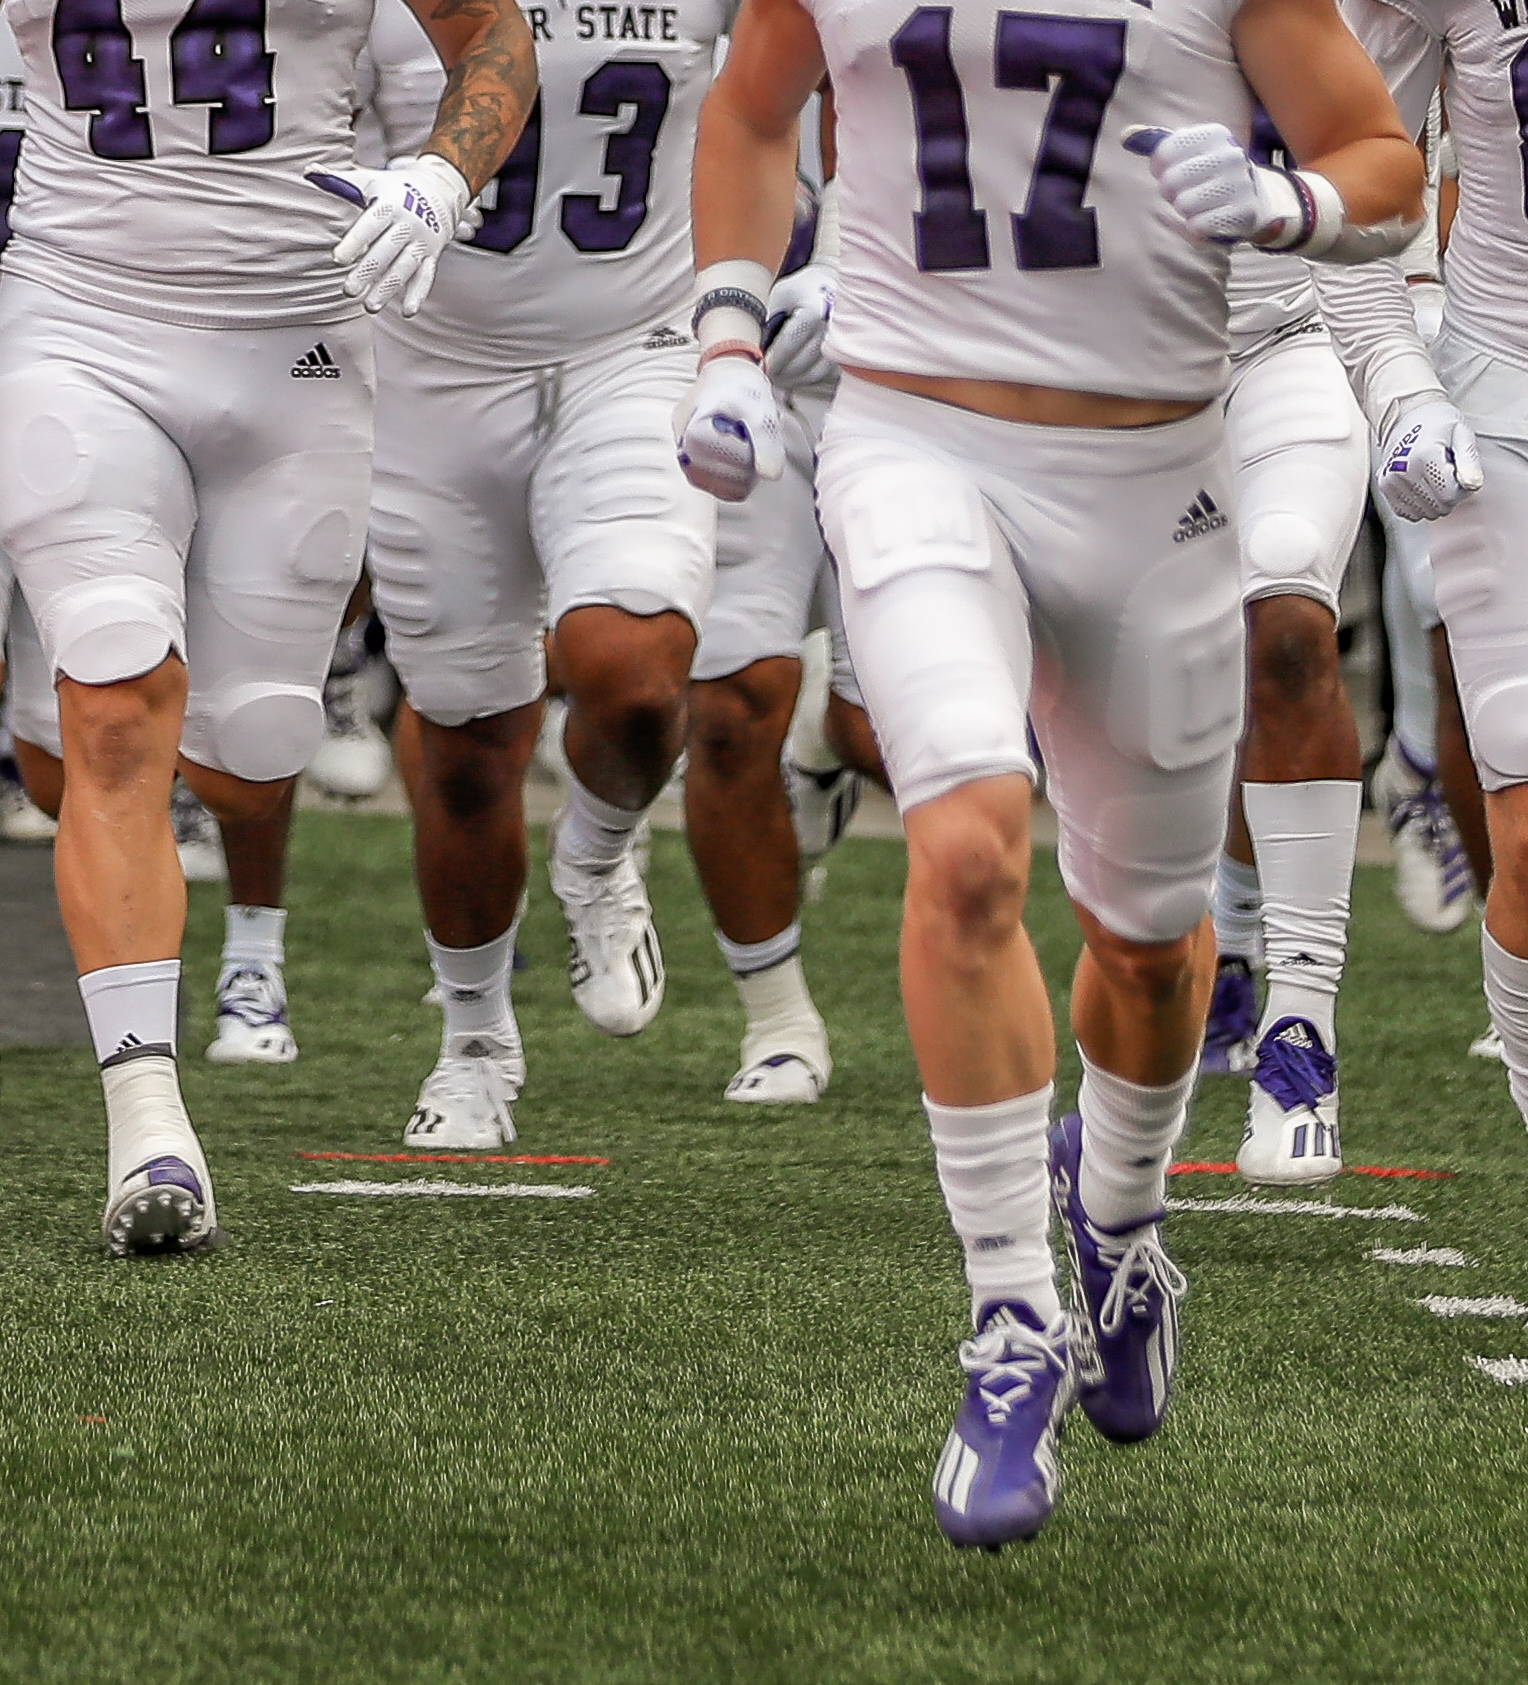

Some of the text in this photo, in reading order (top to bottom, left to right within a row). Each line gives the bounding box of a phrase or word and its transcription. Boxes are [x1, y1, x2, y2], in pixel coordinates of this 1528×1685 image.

[577, 7, 679, 42] STATE
[890, 5, 1128, 271] 17
[291, 366, 340, 379] adidas
[1172, 515, 1228, 544] adidas
